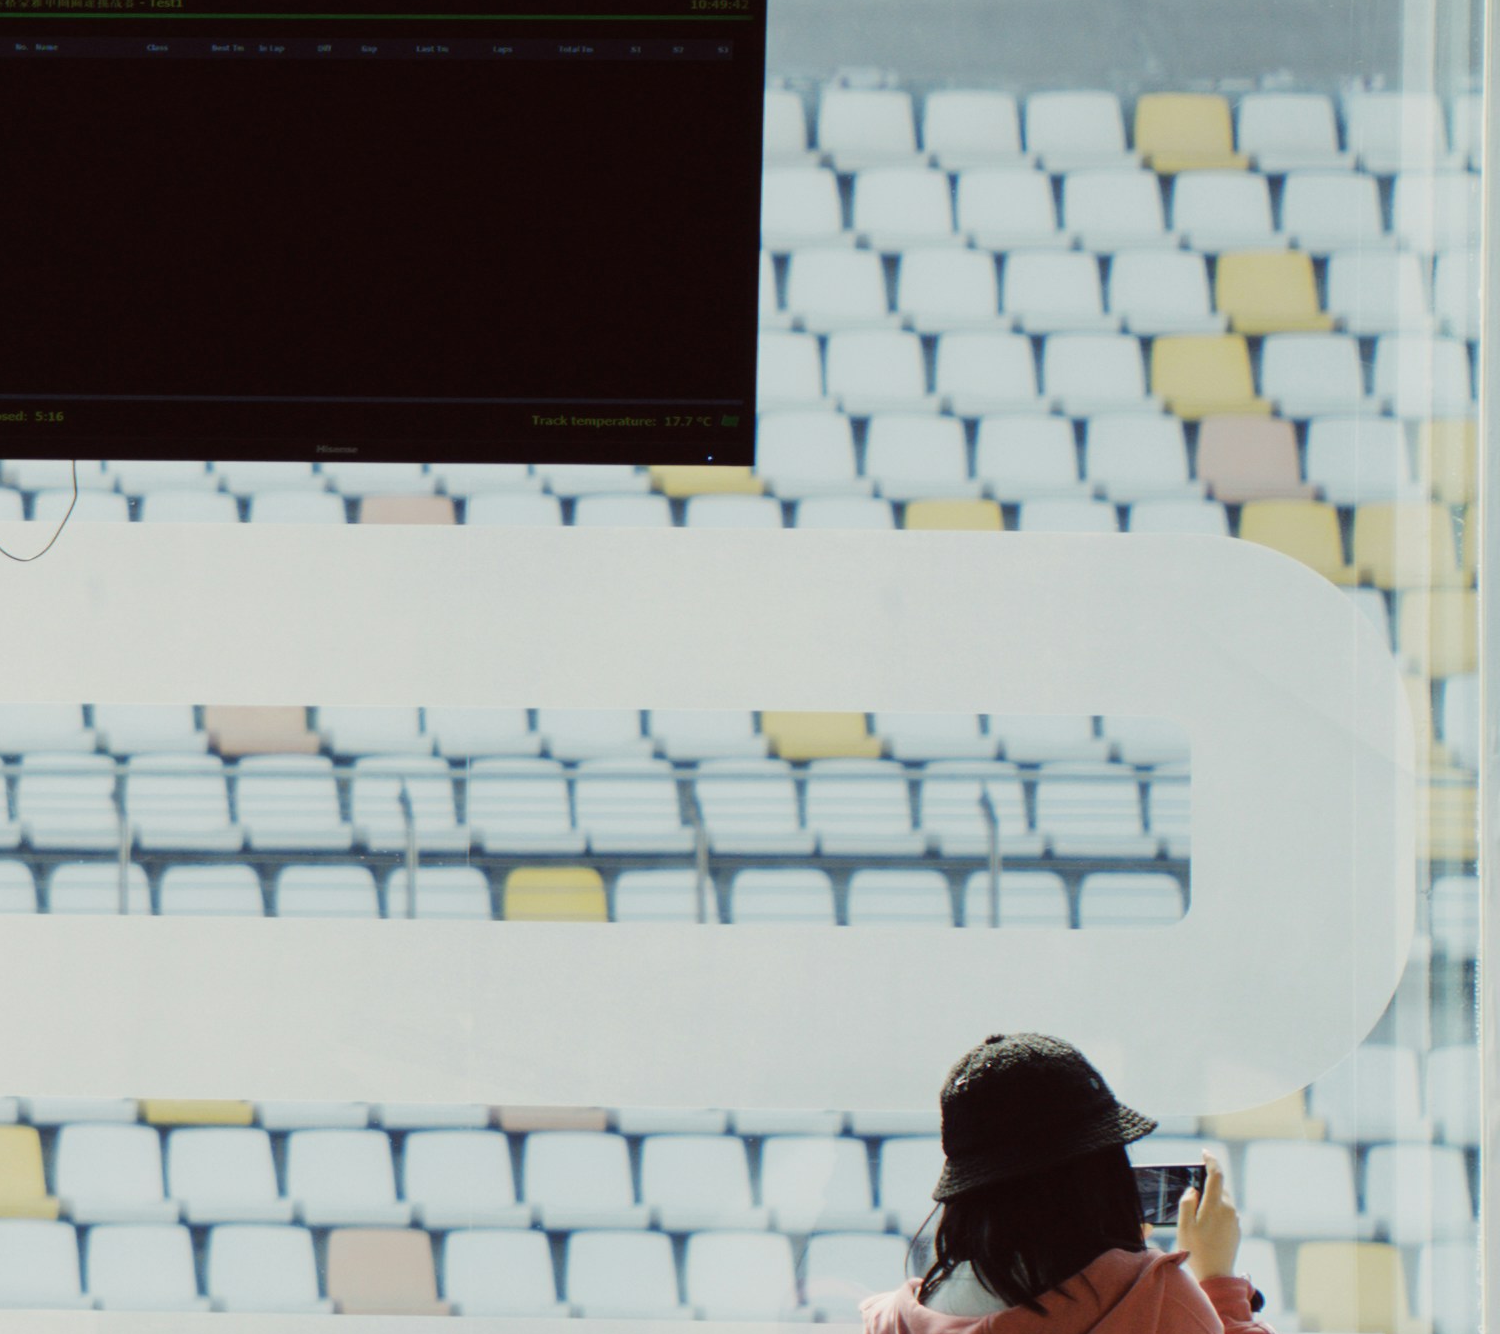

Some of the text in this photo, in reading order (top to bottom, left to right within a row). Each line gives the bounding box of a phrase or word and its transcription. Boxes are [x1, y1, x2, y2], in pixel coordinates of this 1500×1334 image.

[689, 0, 750, 11] 10:49:42
[35, 42, 59, 53] Name
[146, 43, 169, 53] Class
[360, 44, 378, 56] Gap
[415, 44, 435, 54] Last
[492, 45, 513, 56] Laps
[34, 410, 65, 424] 5:16
[531, 414, 568, 427] Track
[570, 415, 657, 430] temperature:
[664, 415, 692, 427] 17.7
